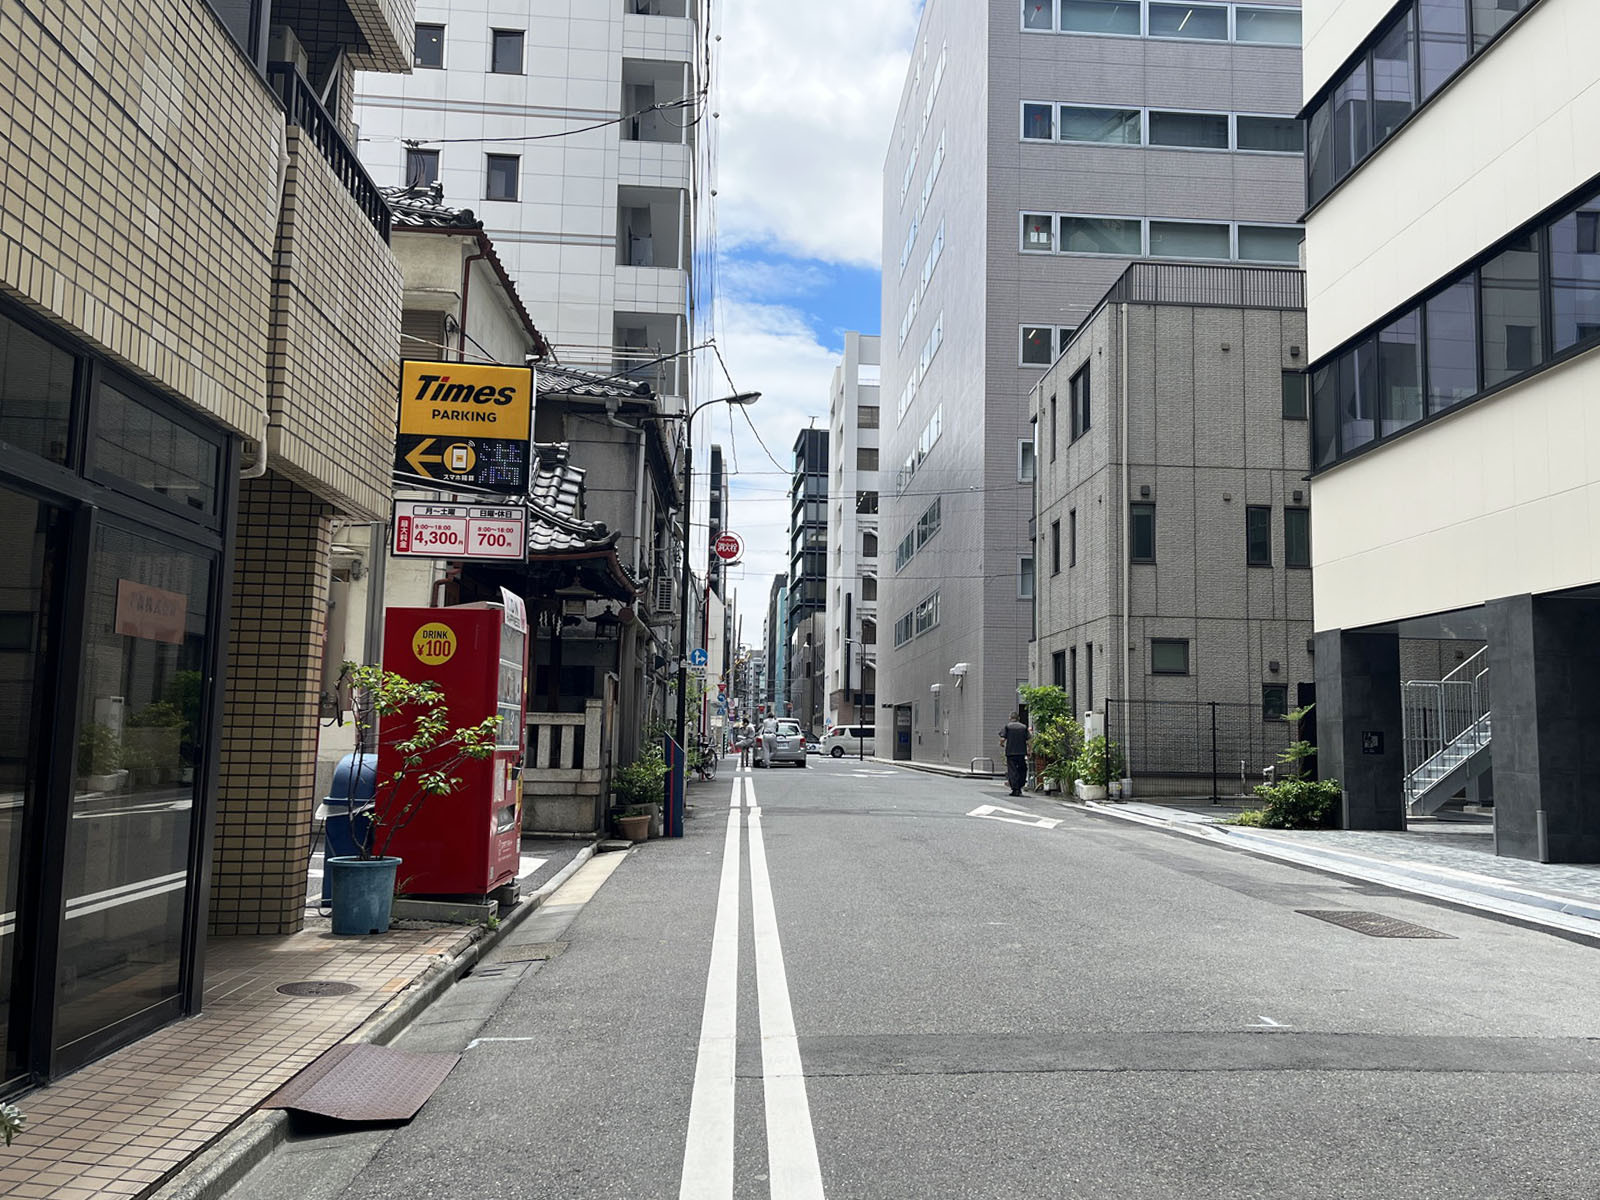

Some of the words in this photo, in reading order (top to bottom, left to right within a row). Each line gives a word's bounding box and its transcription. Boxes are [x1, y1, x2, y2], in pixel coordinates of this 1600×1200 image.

[415, 374, 516, 405] Times
[432, 408, 497, 422] PARKING
[717, 542, 737, 552] 消火栓
[422, 630, 448, 639] DRINK
[417, 640, 451, 657] ¥100
